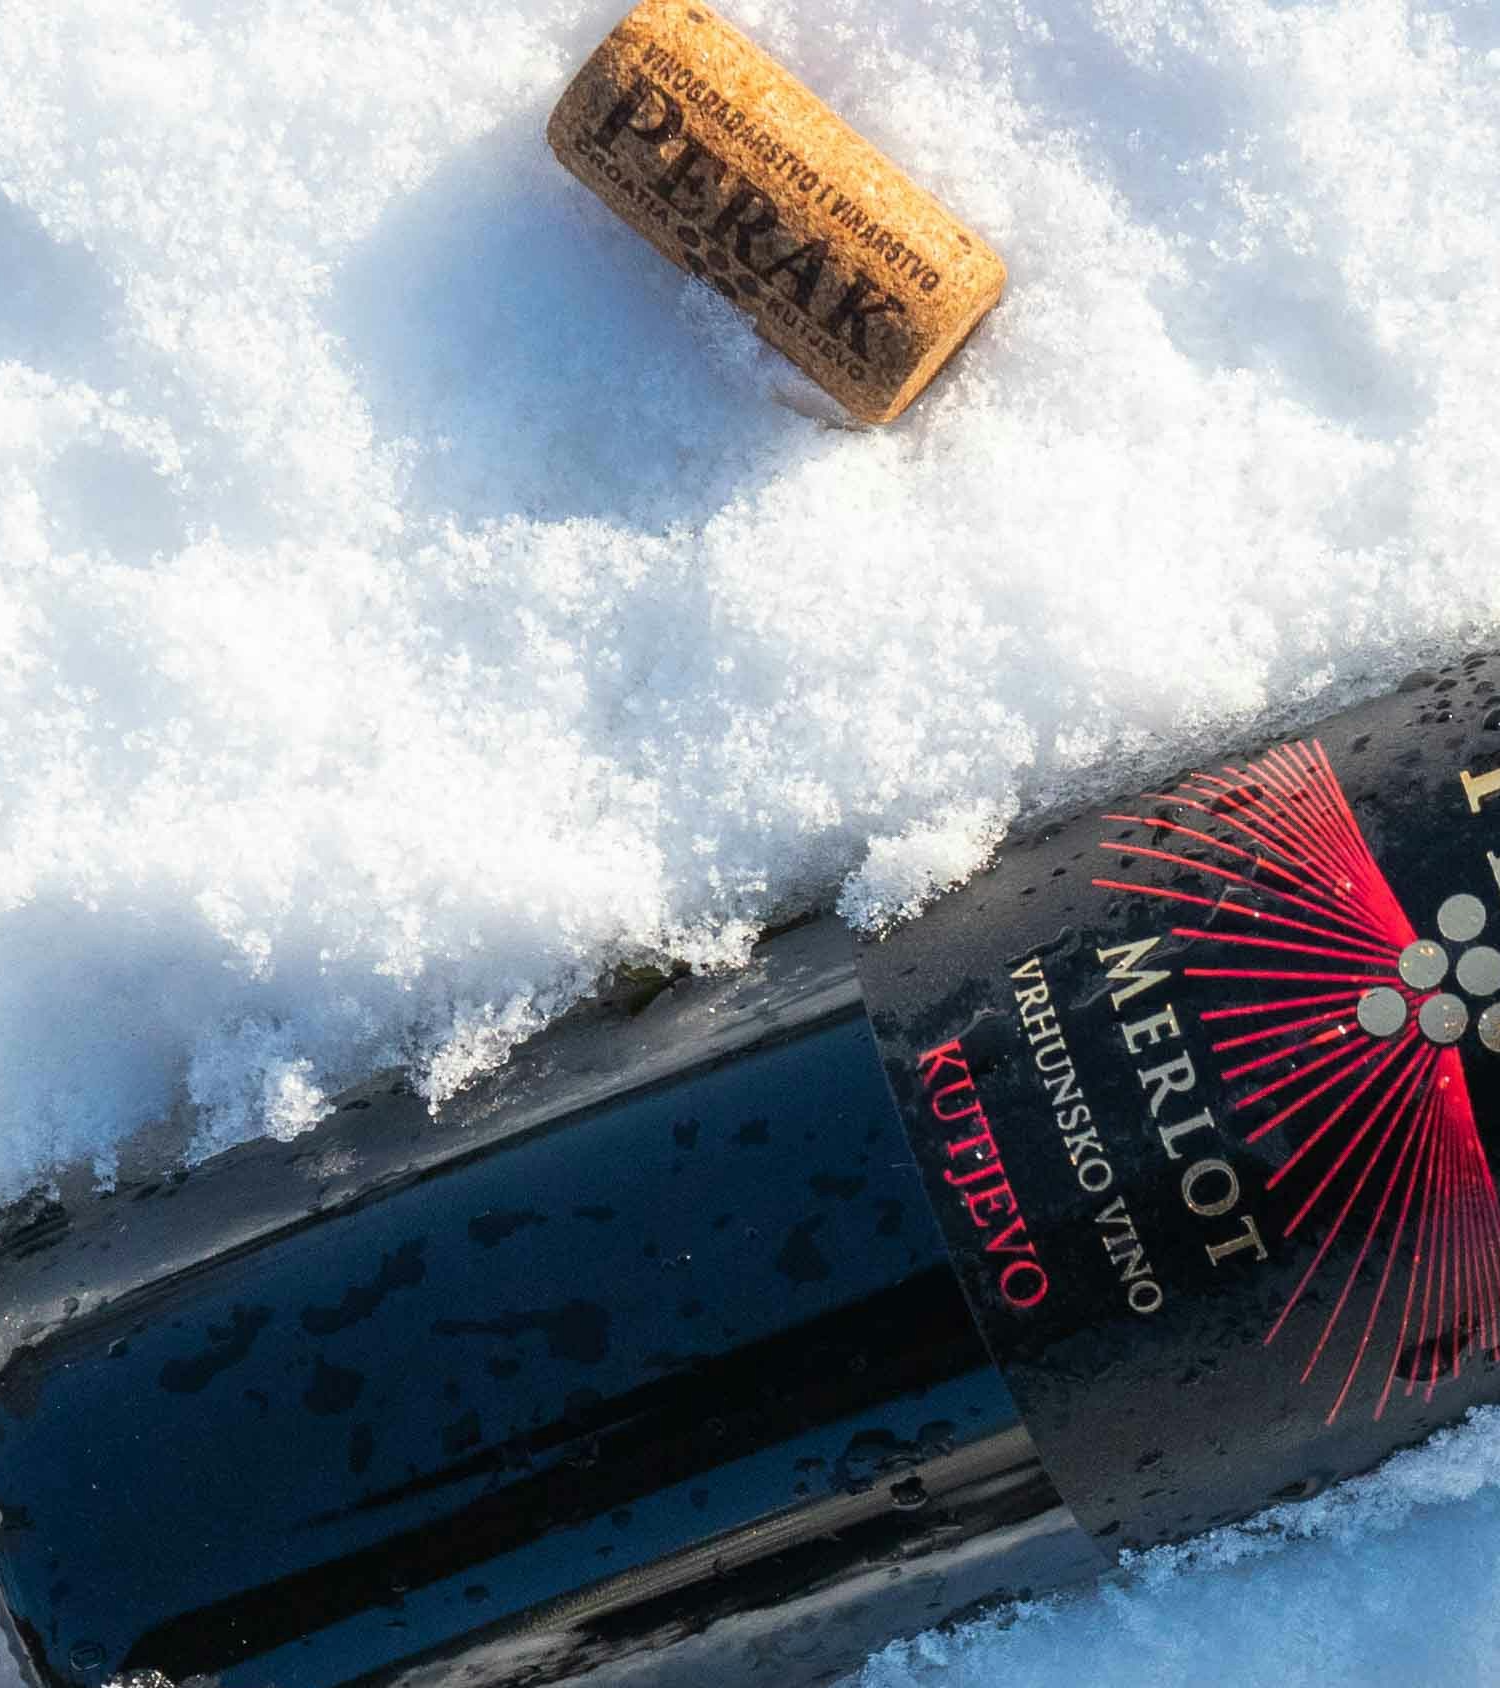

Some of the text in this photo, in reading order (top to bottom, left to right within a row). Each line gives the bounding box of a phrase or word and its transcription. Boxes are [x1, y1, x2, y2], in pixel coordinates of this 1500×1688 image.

[575, 139, 670, 226] CROATIA
[593, 78, 905, 356] PERAK
[829, 198, 940, 293] VINARSTVO
[766, 297, 864, 381] KUTJEVO
[918, 1037, 1050, 1311] KUTJEVO
[1008, 957, 1165, 1315] VRHUNSKO VINO
[1096, 928, 1268, 1268] MERLOT
